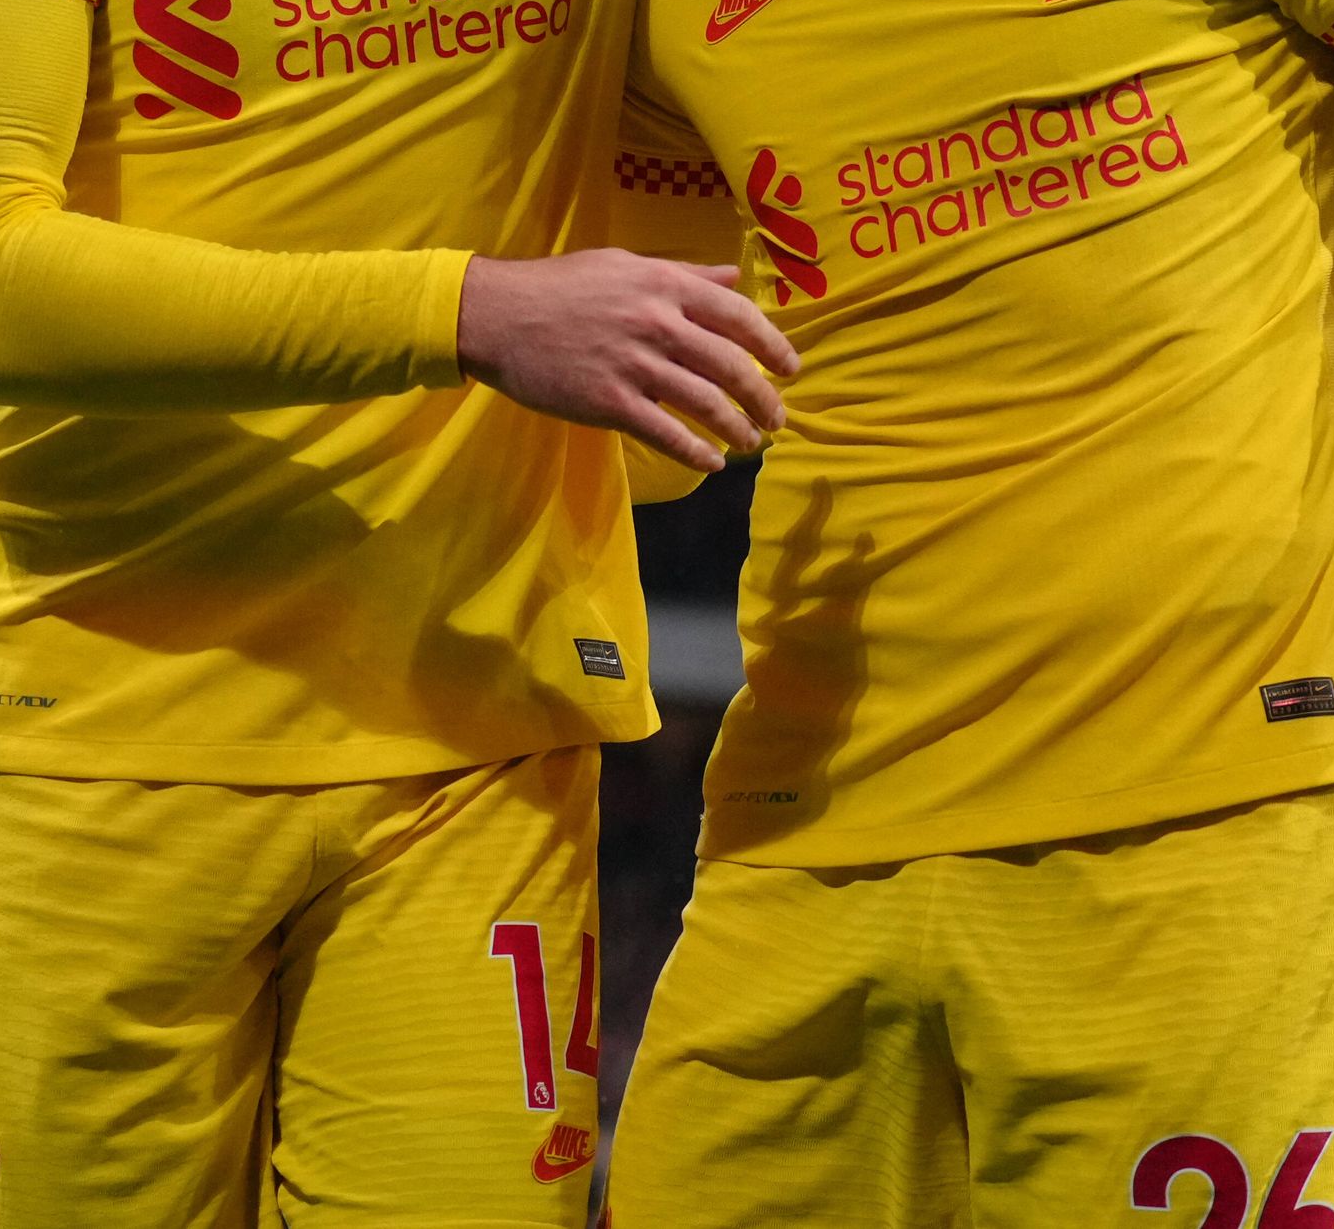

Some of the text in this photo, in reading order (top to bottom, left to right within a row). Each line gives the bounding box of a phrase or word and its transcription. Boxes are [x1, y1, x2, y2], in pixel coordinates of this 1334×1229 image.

[838, 73, 1154, 207] standard
[850, 114, 1189, 259] chartered
[547, 1123, 591, 1160] NIKE
